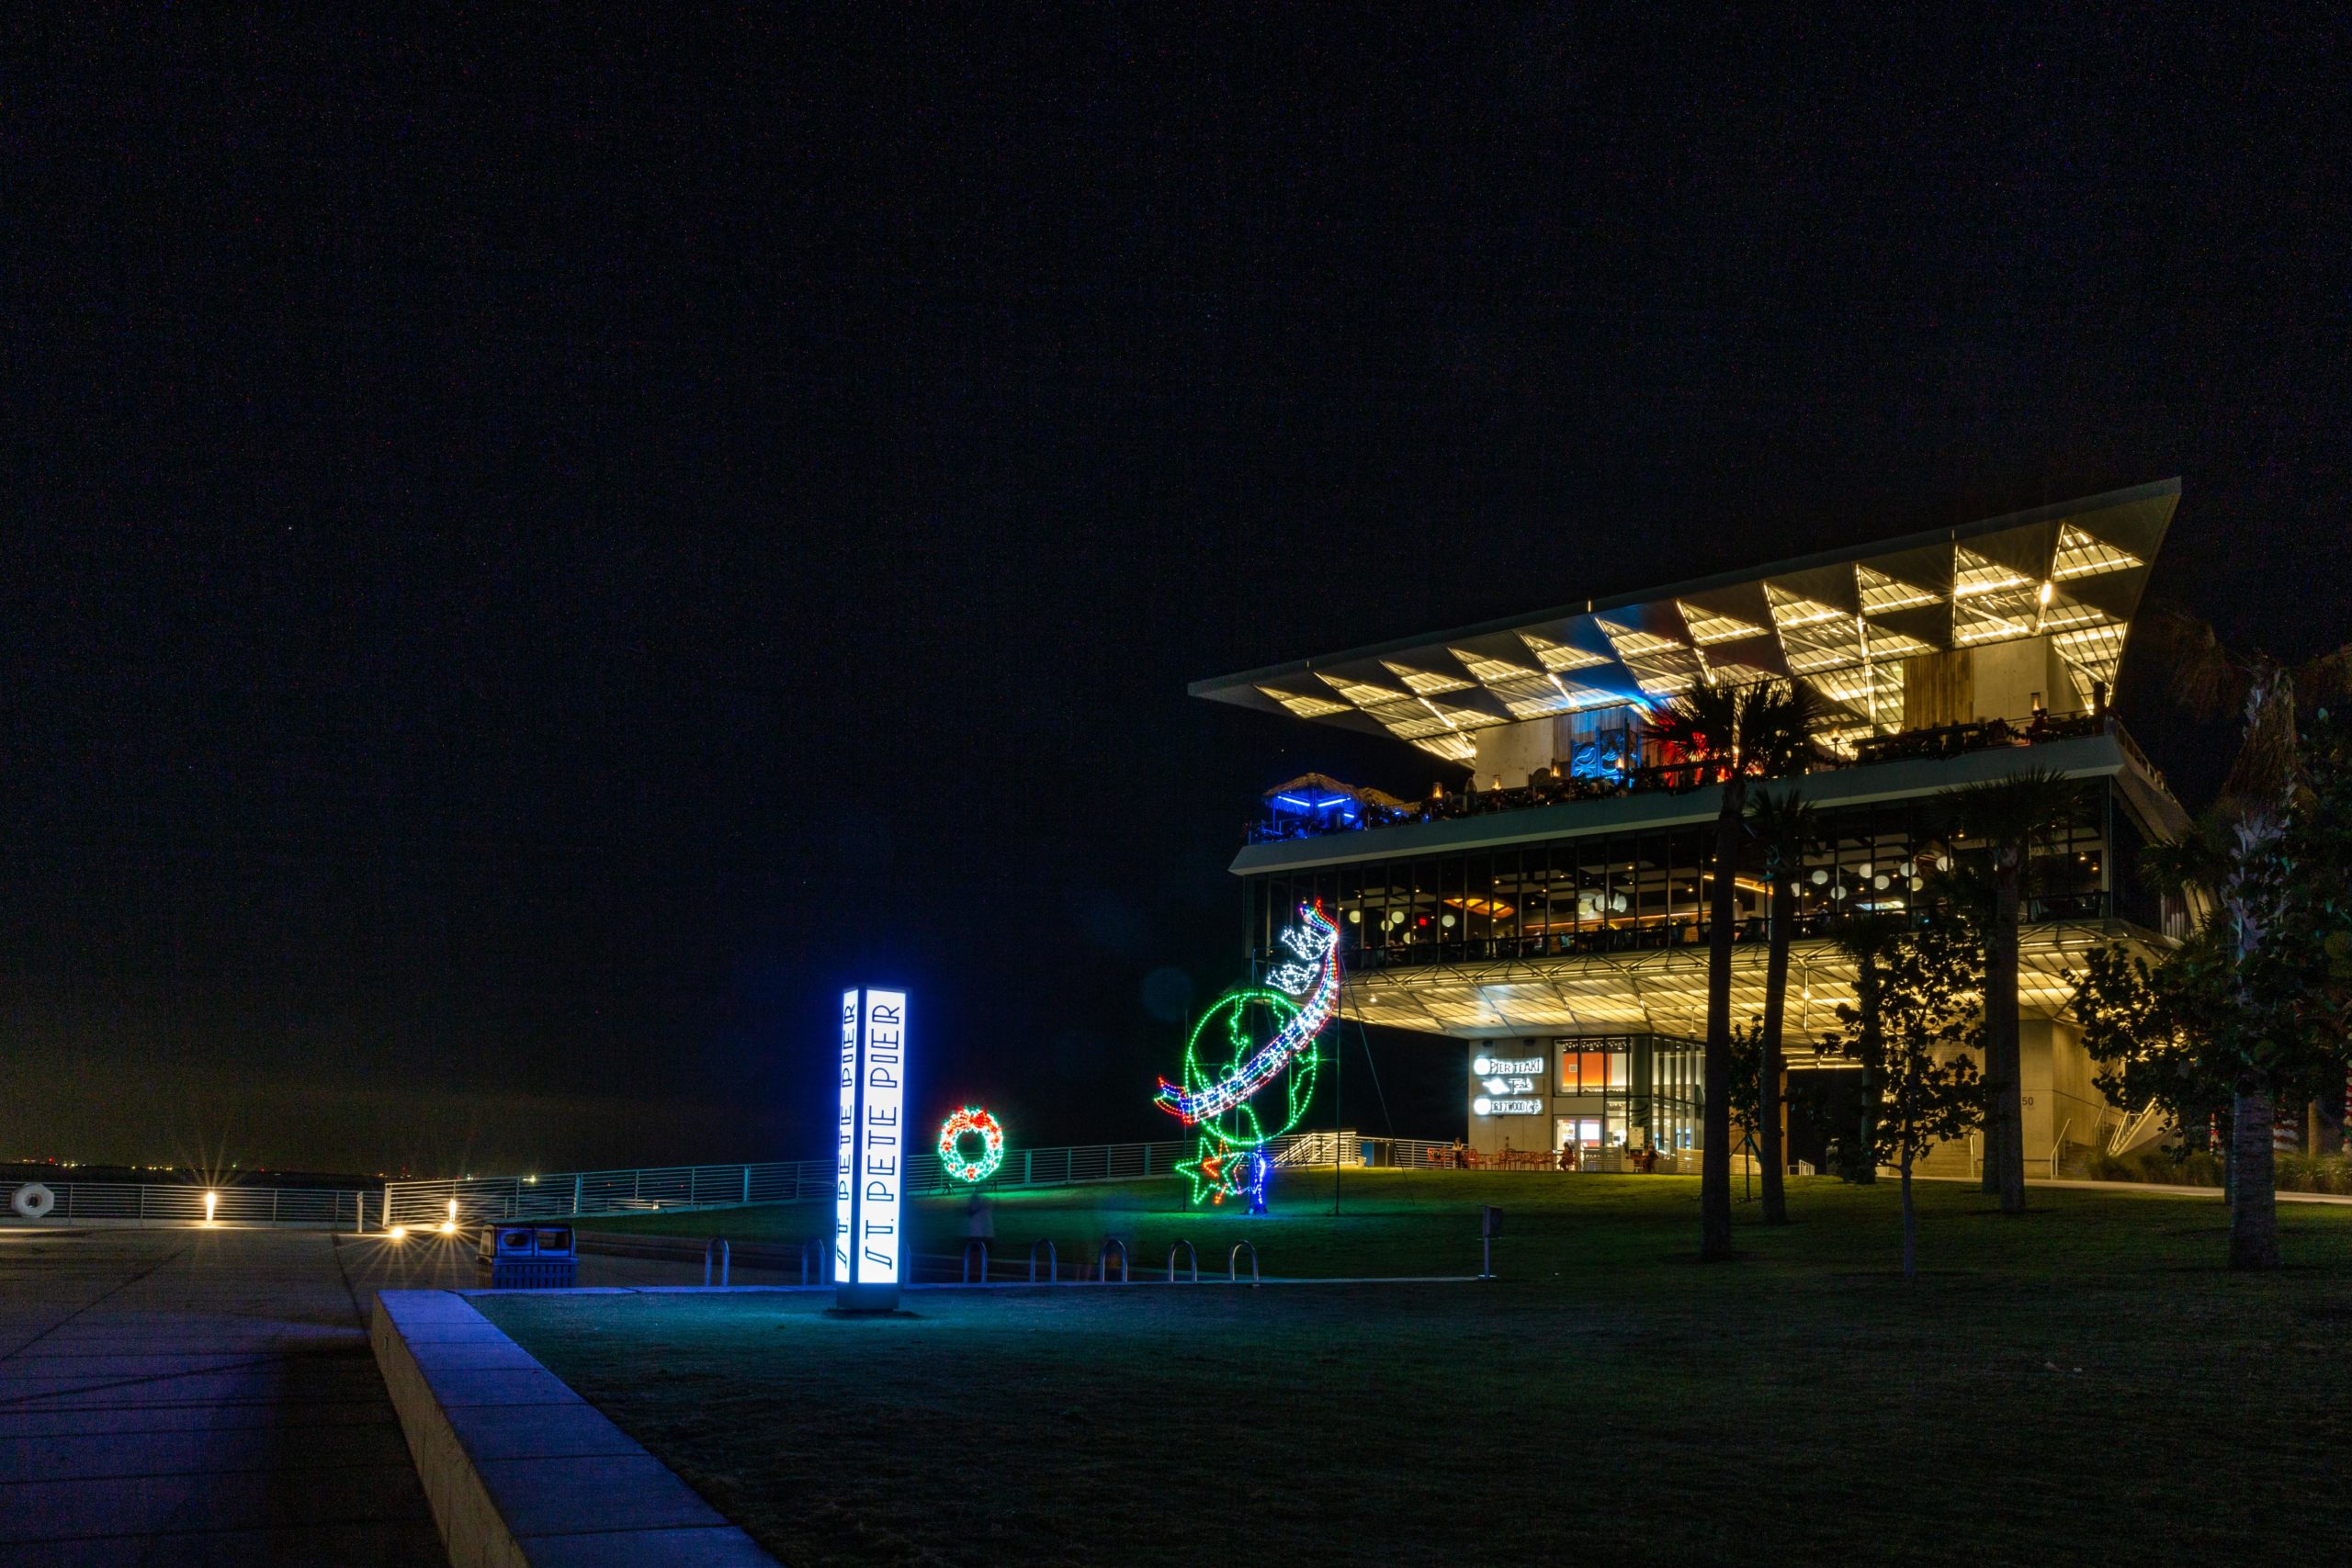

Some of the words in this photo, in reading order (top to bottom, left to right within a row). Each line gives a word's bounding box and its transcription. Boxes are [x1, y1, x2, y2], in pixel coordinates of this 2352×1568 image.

[842, 1003, 855, 1088] PIER
[870, 1004, 899, 1089] PIER
[1490, 1061, 1510, 1073] PIER
[1514, 1059, 1540, 1073] TEAKI
[1508, 1077, 1532, 1094] Teak
[2022, 1097, 2033, 1106] 50
[839, 1104, 853, 1201] PETE
[866, 1106, 897, 1201] PETE
[865, 1218, 894, 1269] ST.
